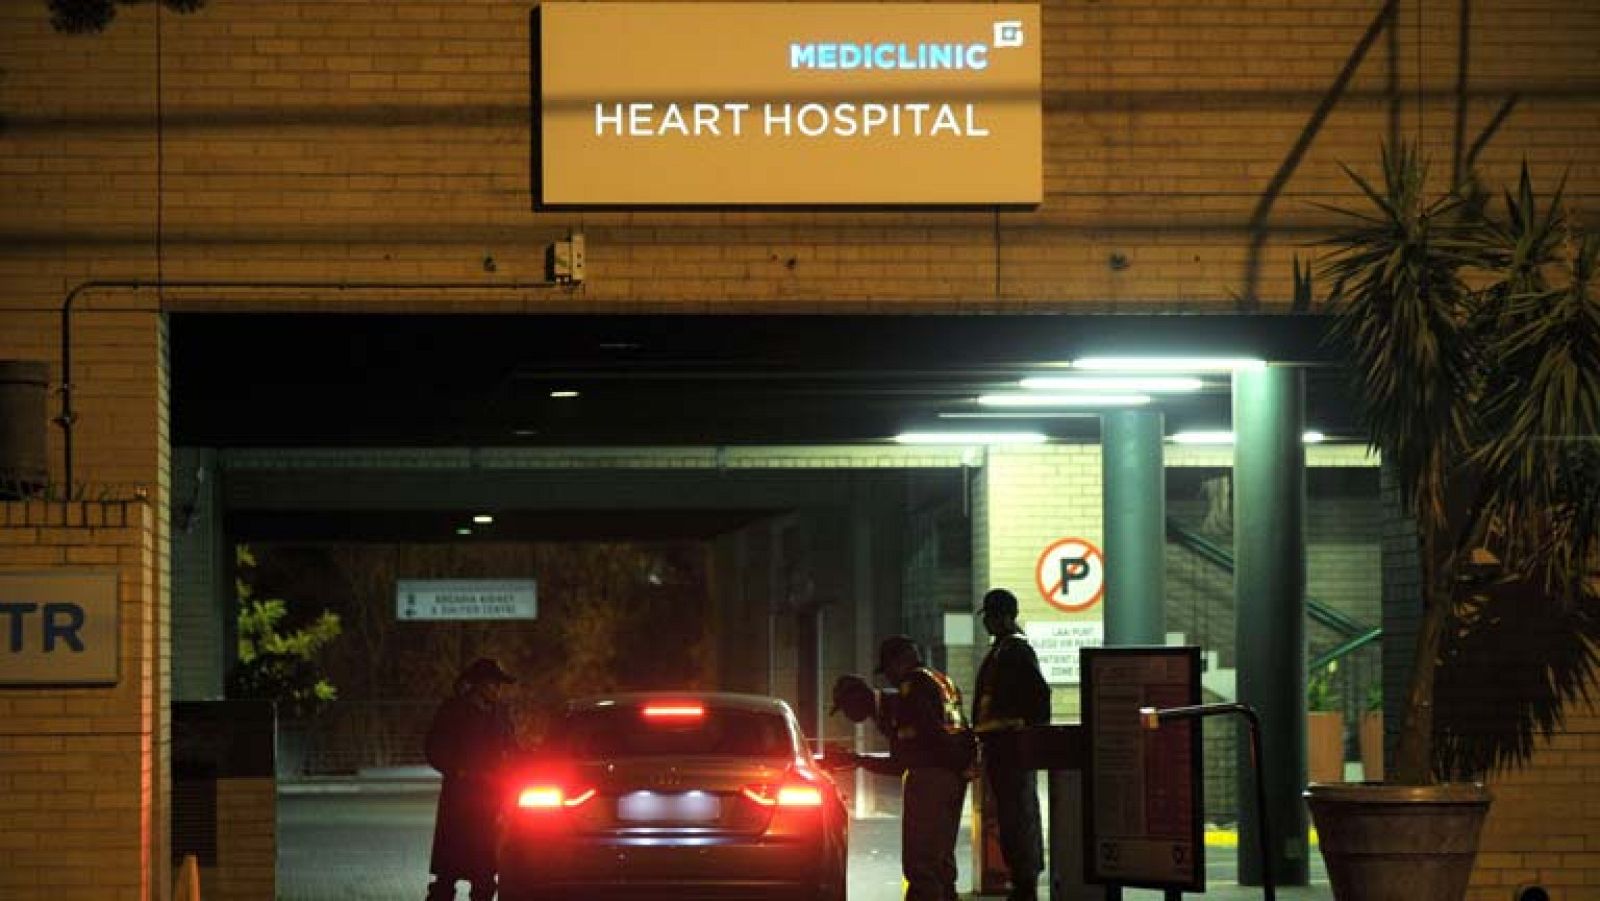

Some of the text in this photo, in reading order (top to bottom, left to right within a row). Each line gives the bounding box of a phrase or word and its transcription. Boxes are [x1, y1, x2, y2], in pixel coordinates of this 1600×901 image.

[790, 43, 989, 70] MEDICLINIC
[595, 102, 989, 136] HEART HOSPITAL
